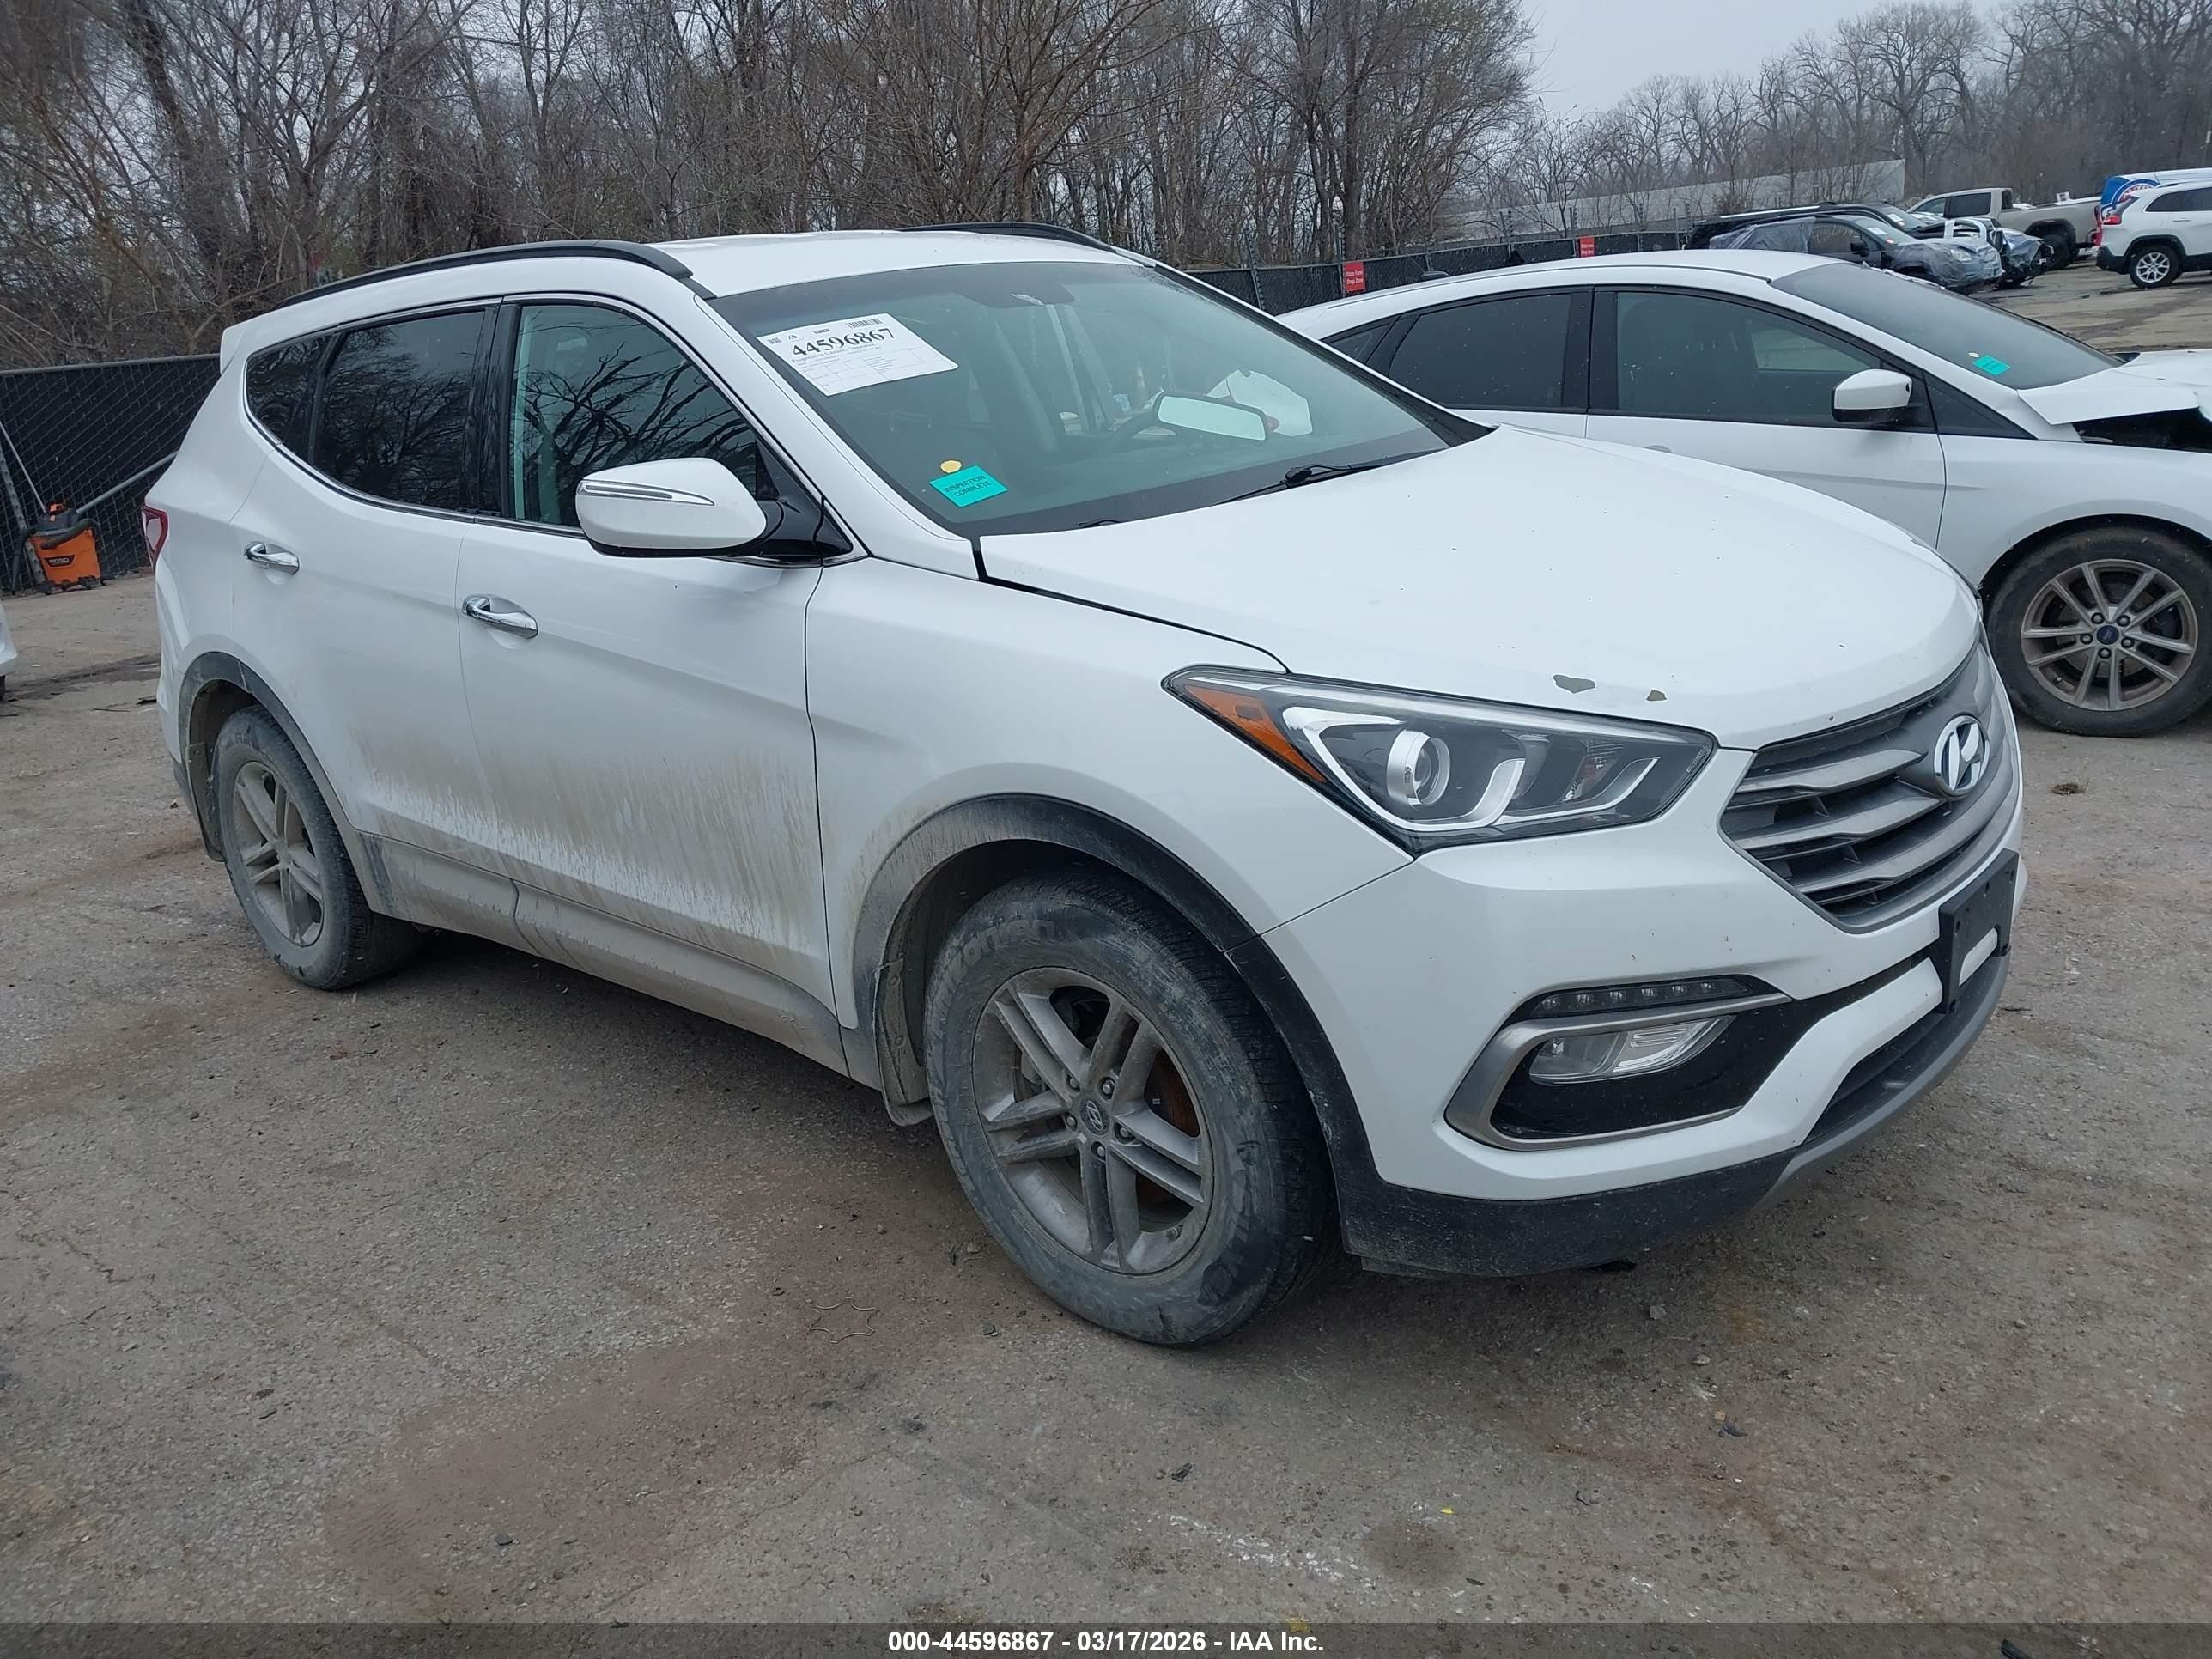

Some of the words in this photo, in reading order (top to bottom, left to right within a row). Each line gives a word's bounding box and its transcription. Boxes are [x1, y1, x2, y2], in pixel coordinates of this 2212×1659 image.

[792, 328, 894, 356] 44596867
[944, 474, 987, 493] INSPECTION
[953, 481, 991, 496] COMPLETE
